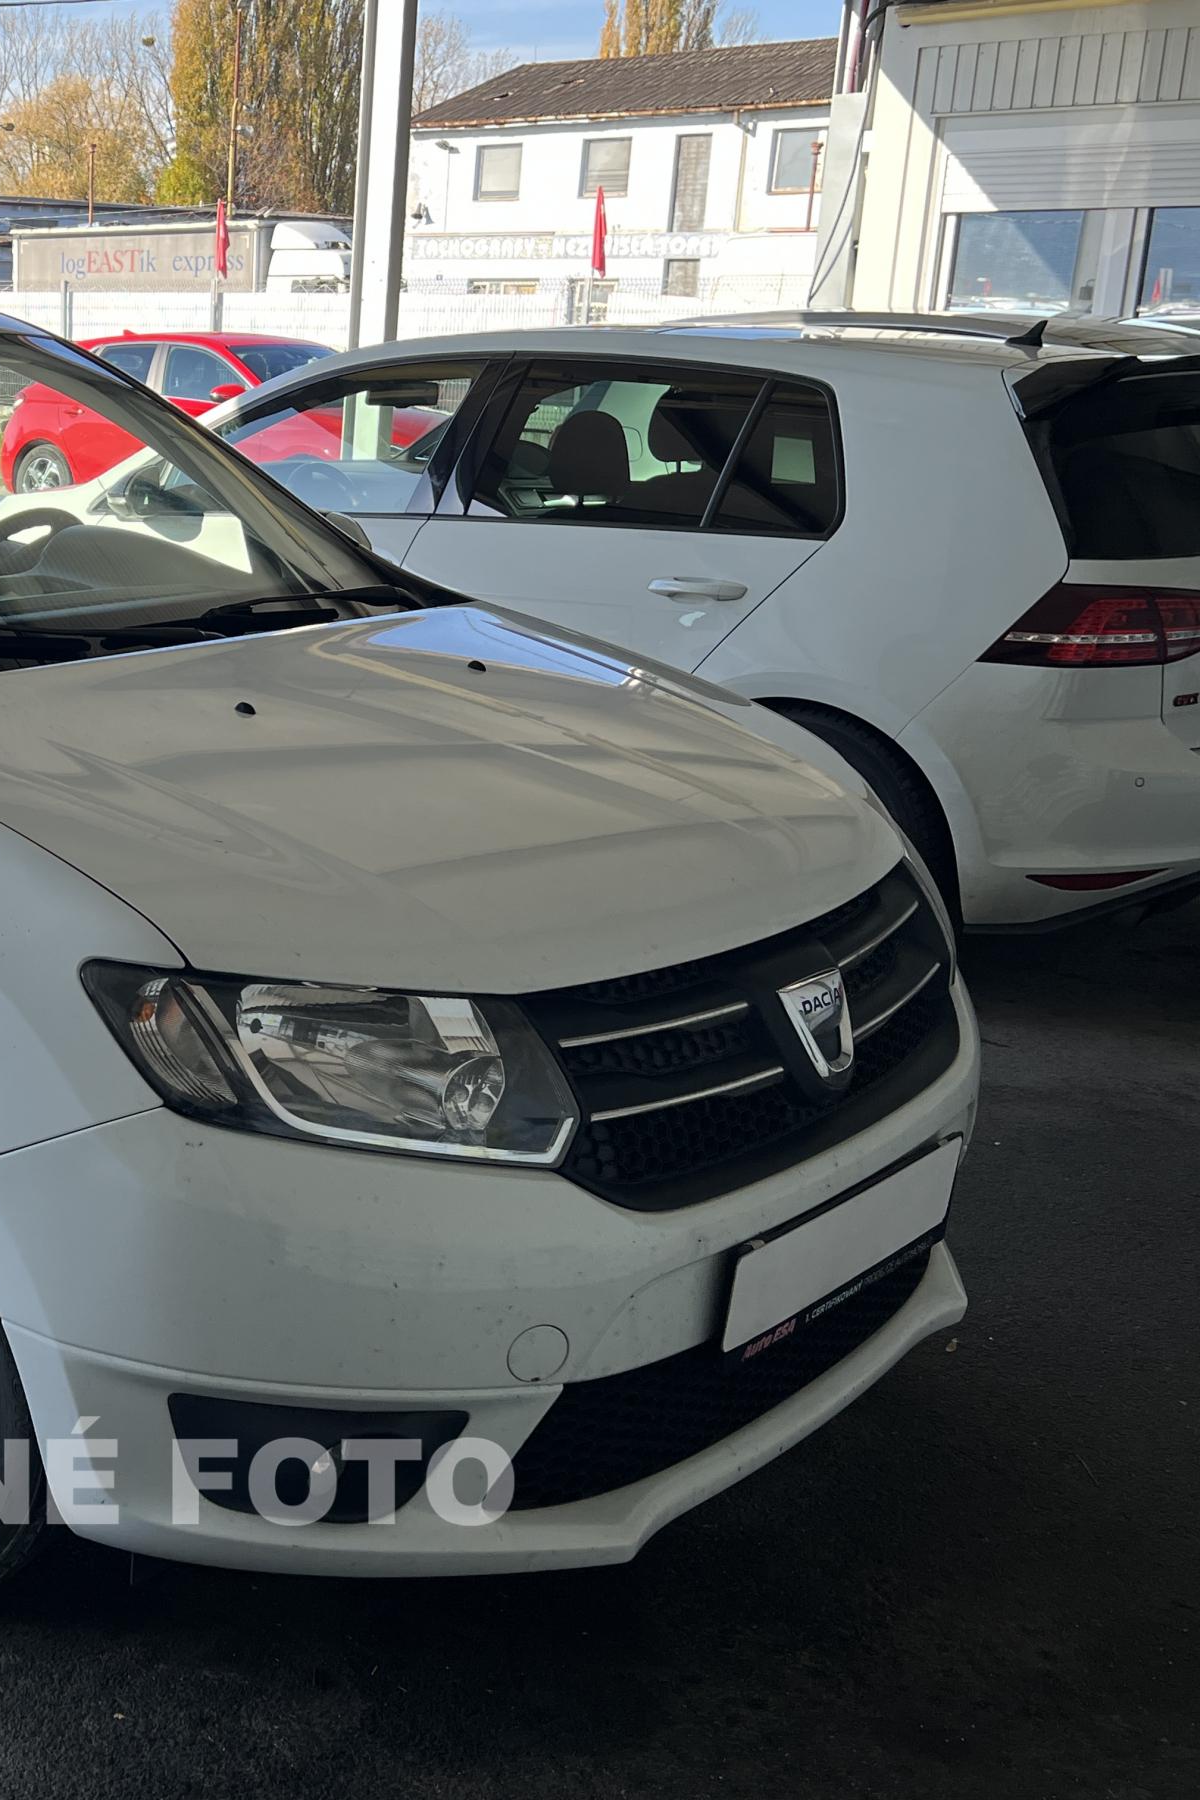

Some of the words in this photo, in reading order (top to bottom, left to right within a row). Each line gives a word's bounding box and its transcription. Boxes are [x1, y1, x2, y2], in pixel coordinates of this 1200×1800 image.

[60, 248, 158, 280] logEASTik
[172, 253, 244, 278] exprss
[801, 986, 841, 1016] DACIA
